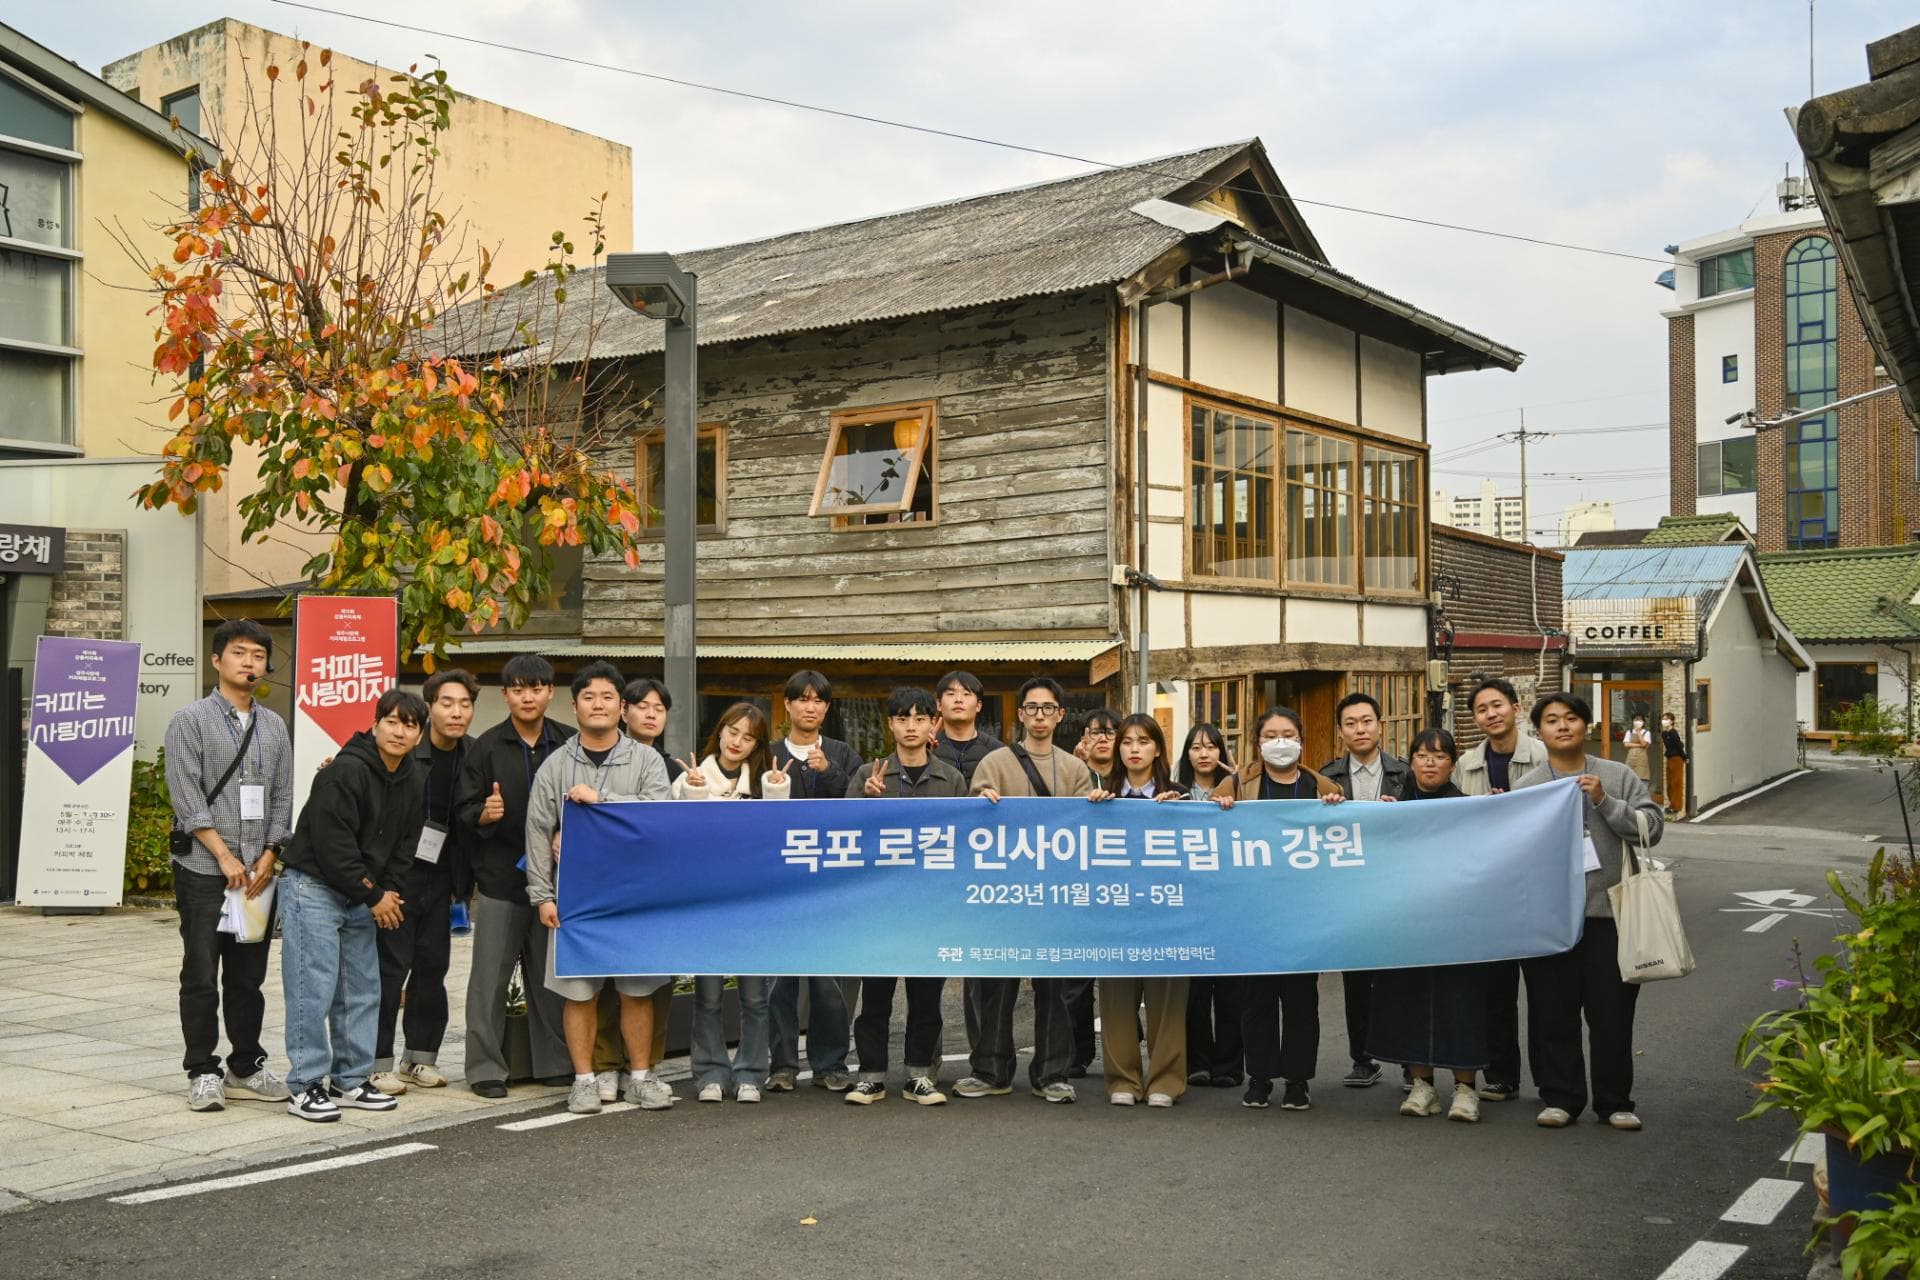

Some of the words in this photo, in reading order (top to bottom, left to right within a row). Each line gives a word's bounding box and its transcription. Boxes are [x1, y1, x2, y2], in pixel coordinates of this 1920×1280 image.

[1585, 626, 1664, 639] COFFEE
[143, 653, 194, 666] Coffee
[311, 653, 384, 680] 커피는
[138, 682, 170, 697] tory
[35, 690, 107, 713] 커피는
[32, 715, 134, 744] 사랑이지!
[781, 828, 865, 873] 목포
[874, 825, 956, 871] 로컬
[967, 824, 1132, 871] 인사이트
[1141, 827, 1220, 872] 트립
[1231, 830, 1272, 867] in
[1281, 823, 1366, 870] 강원
[965, 882, 1044, 906] 2023년
[1049, 882, 1090, 907] 11월
[1096, 883, 1130, 907] 3일
[1150, 883, 1185, 907] 5일
[936, 947, 963, 962] 주관
[969, 947, 1033, 962] 목포대학교
[1036, 947, 1124, 962] 로컬크리에이터
[1127, 946, 1217, 962] 양성산학협력단
[1635, 958, 1664, 971] NISSAN
